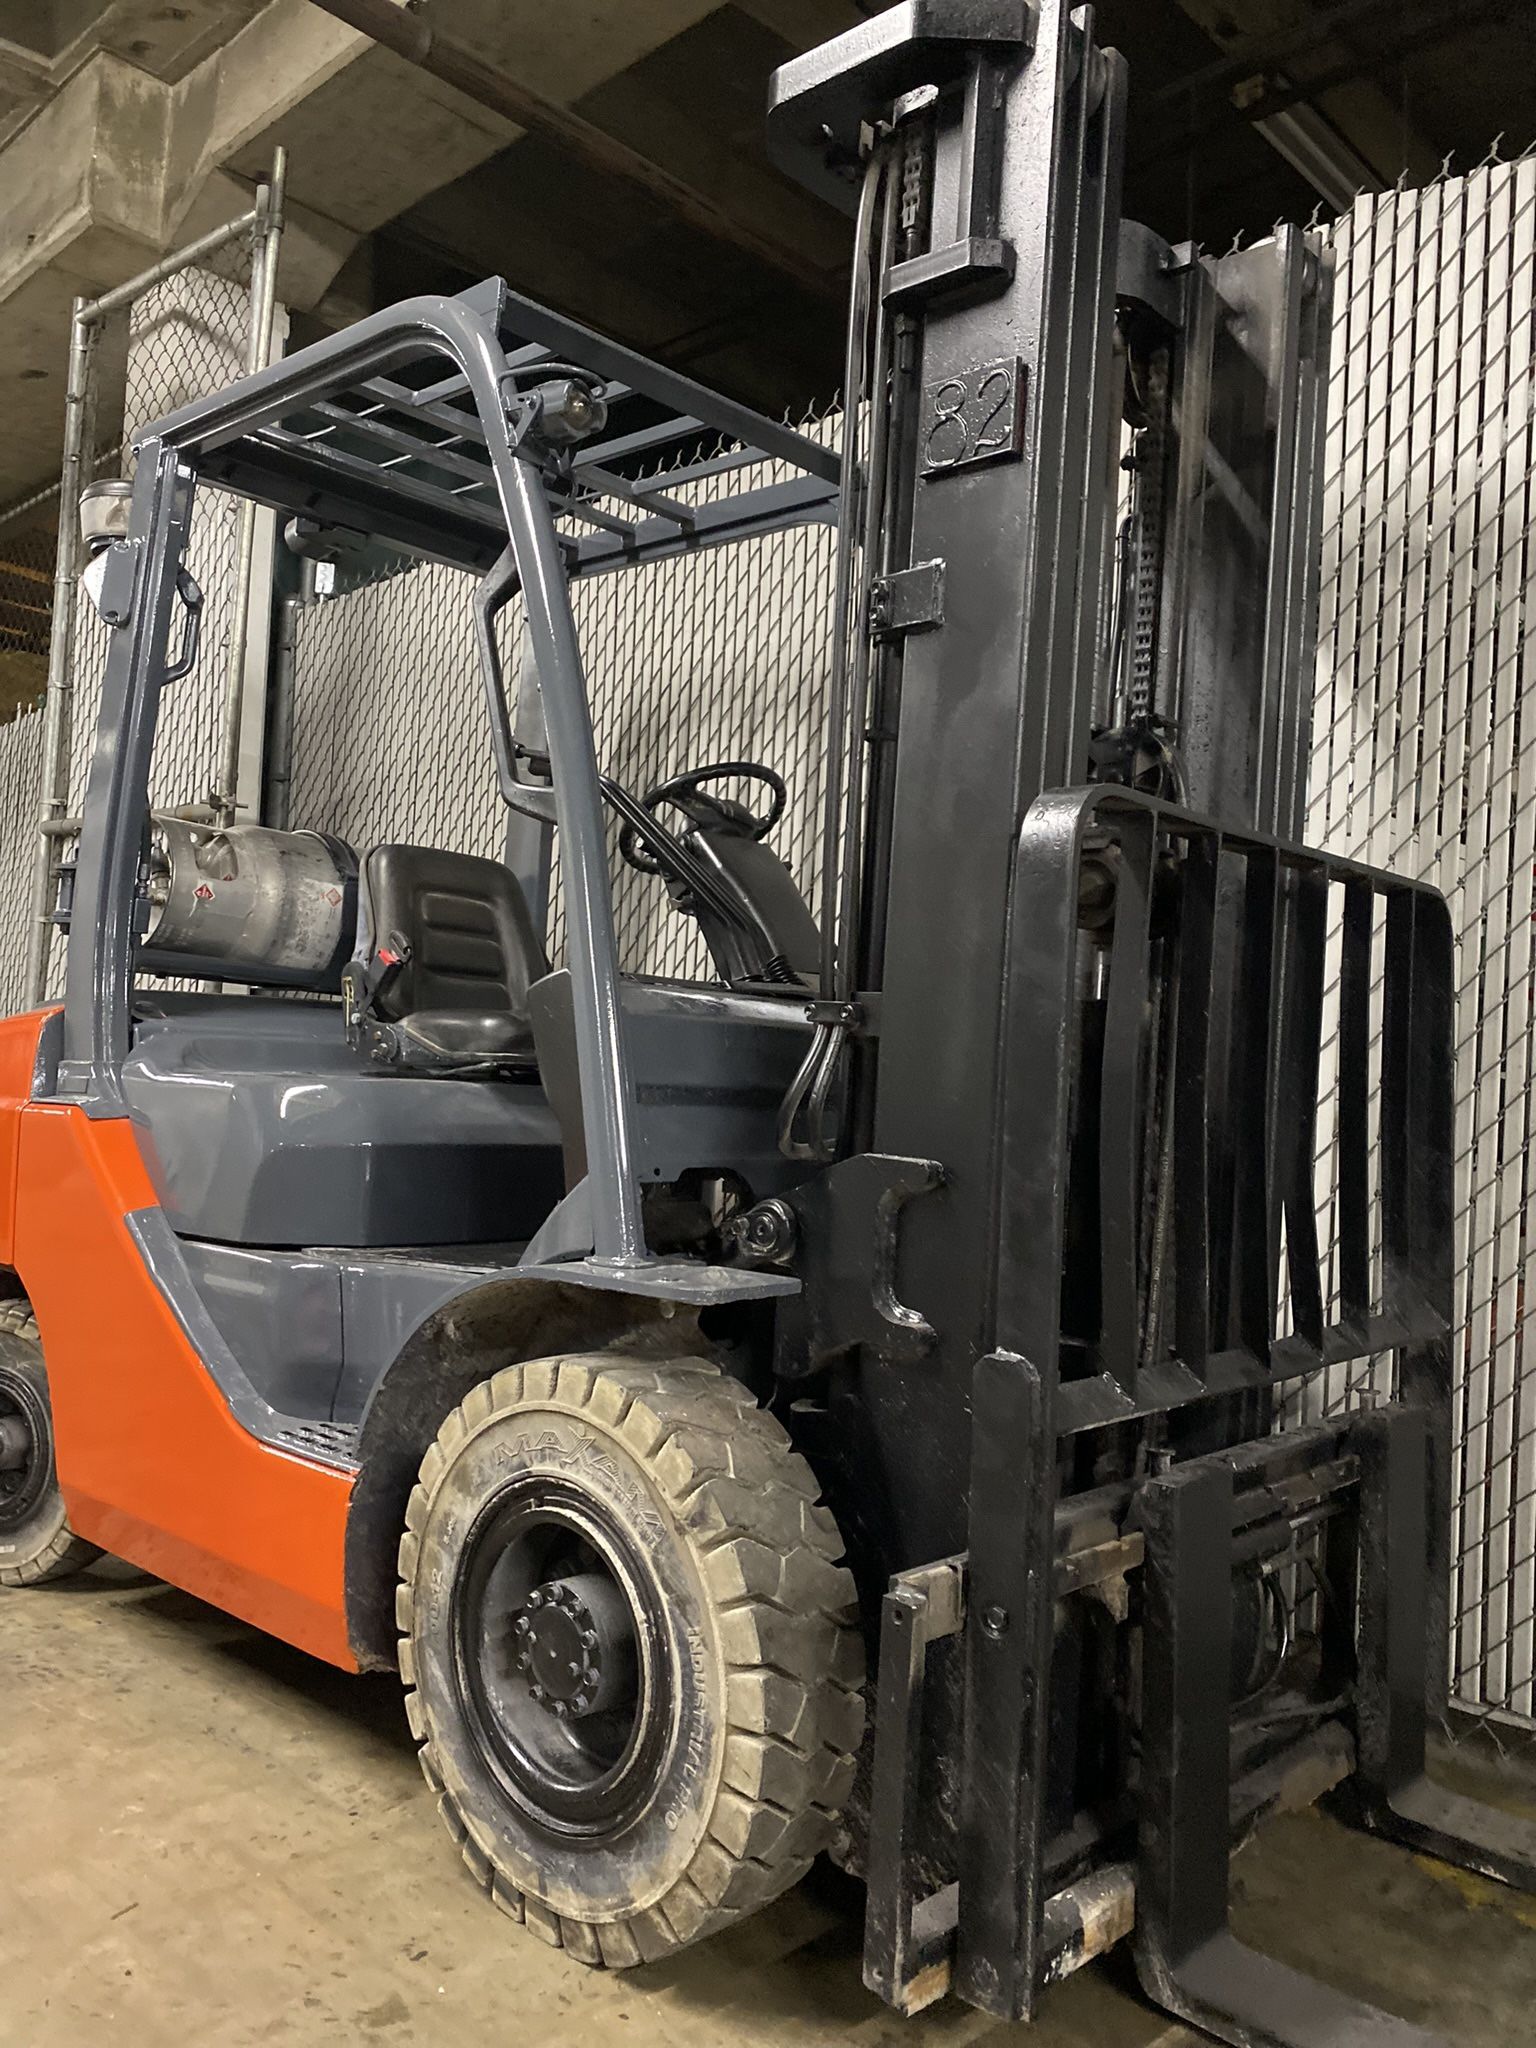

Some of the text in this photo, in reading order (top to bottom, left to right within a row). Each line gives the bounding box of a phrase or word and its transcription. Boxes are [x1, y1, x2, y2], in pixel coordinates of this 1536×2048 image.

[925, 367, 1012, 468] 82
[493, 1423, 667, 1550] MAXAM
[664, 1627, 706, 1831] INDUSTRIAL PRO
